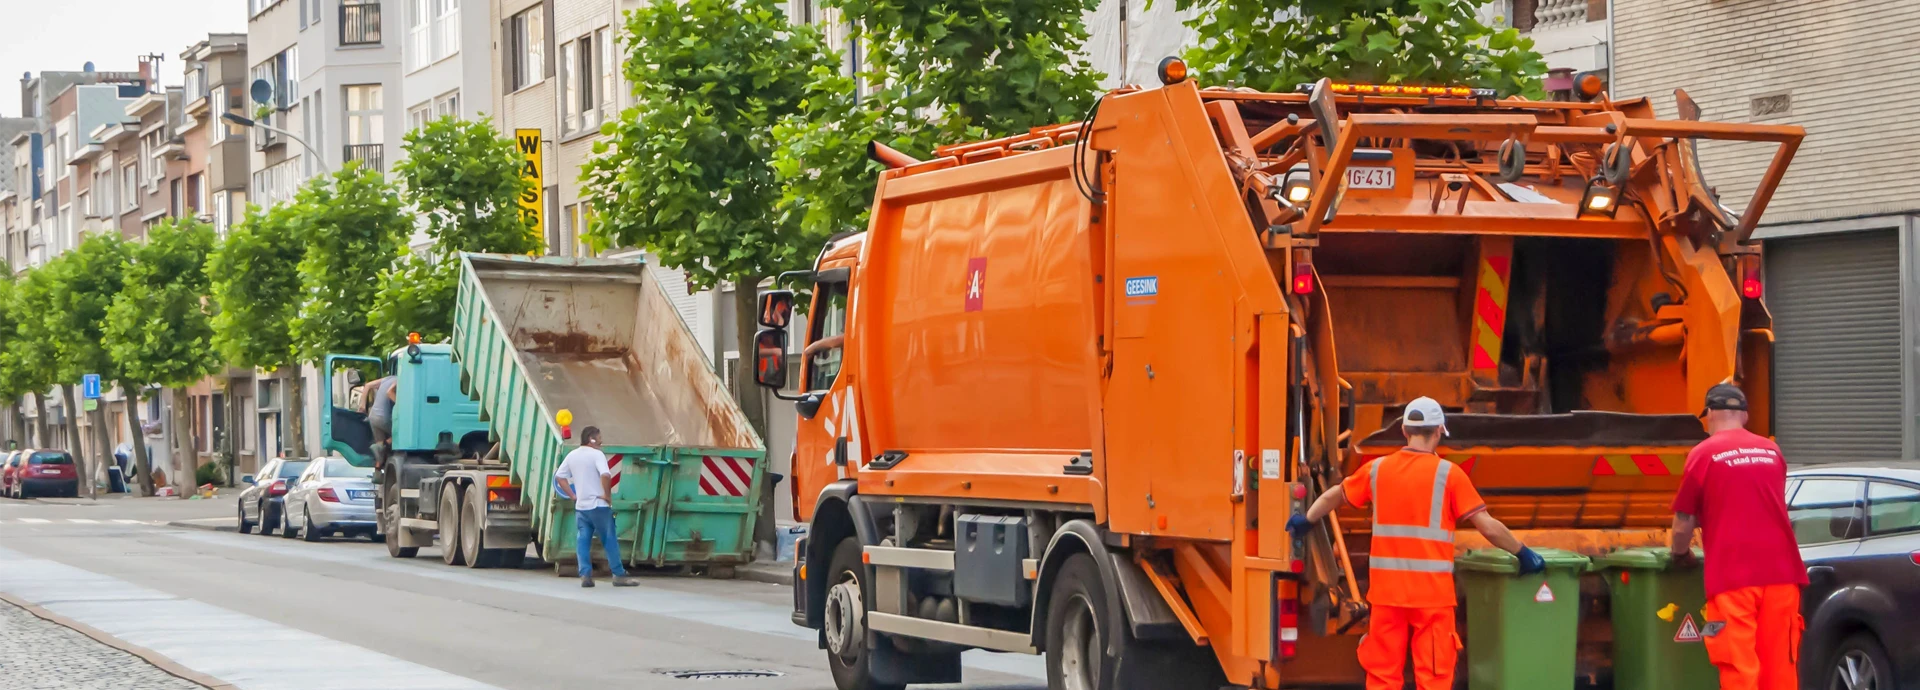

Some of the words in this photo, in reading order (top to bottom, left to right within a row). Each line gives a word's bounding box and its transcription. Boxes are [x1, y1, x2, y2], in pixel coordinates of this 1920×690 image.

[969, 269, 979, 299] A
[1126, 279, 1157, 295] GEESINK
[1712, 449, 1739, 462] Samen
[1733, 456, 1750, 465] stad
